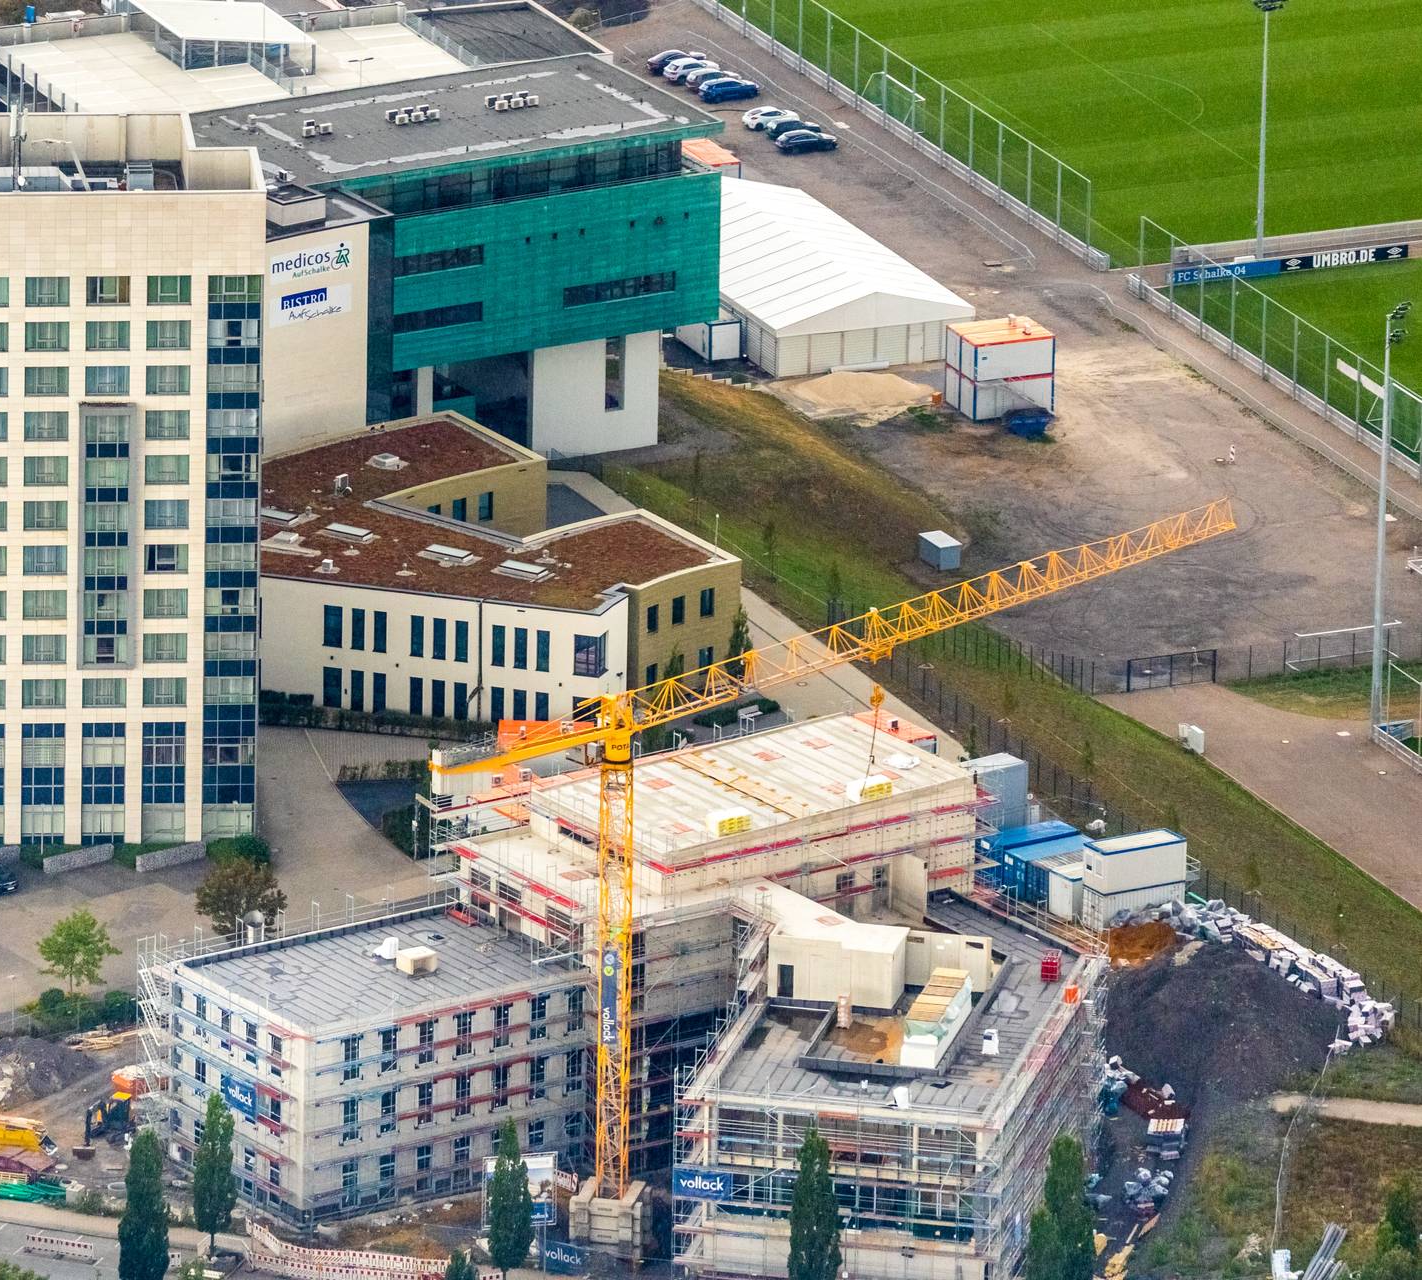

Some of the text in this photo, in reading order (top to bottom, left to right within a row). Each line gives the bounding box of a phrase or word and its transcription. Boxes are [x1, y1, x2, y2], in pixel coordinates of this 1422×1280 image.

[272, 251, 331, 274] medicos
[1312, 248, 1376, 268] UMBRO.DE
[1178, 271, 1191, 281] FC
[1234, 265, 1246, 275] 04
[283, 292, 326, 310] BISTRO
[603, 1007, 616, 1042] vollack
[227, 1084, 253, 1107] vollack
[680, 1175, 724, 1191] vollack
[545, 1248, 582, 1265] vollack
